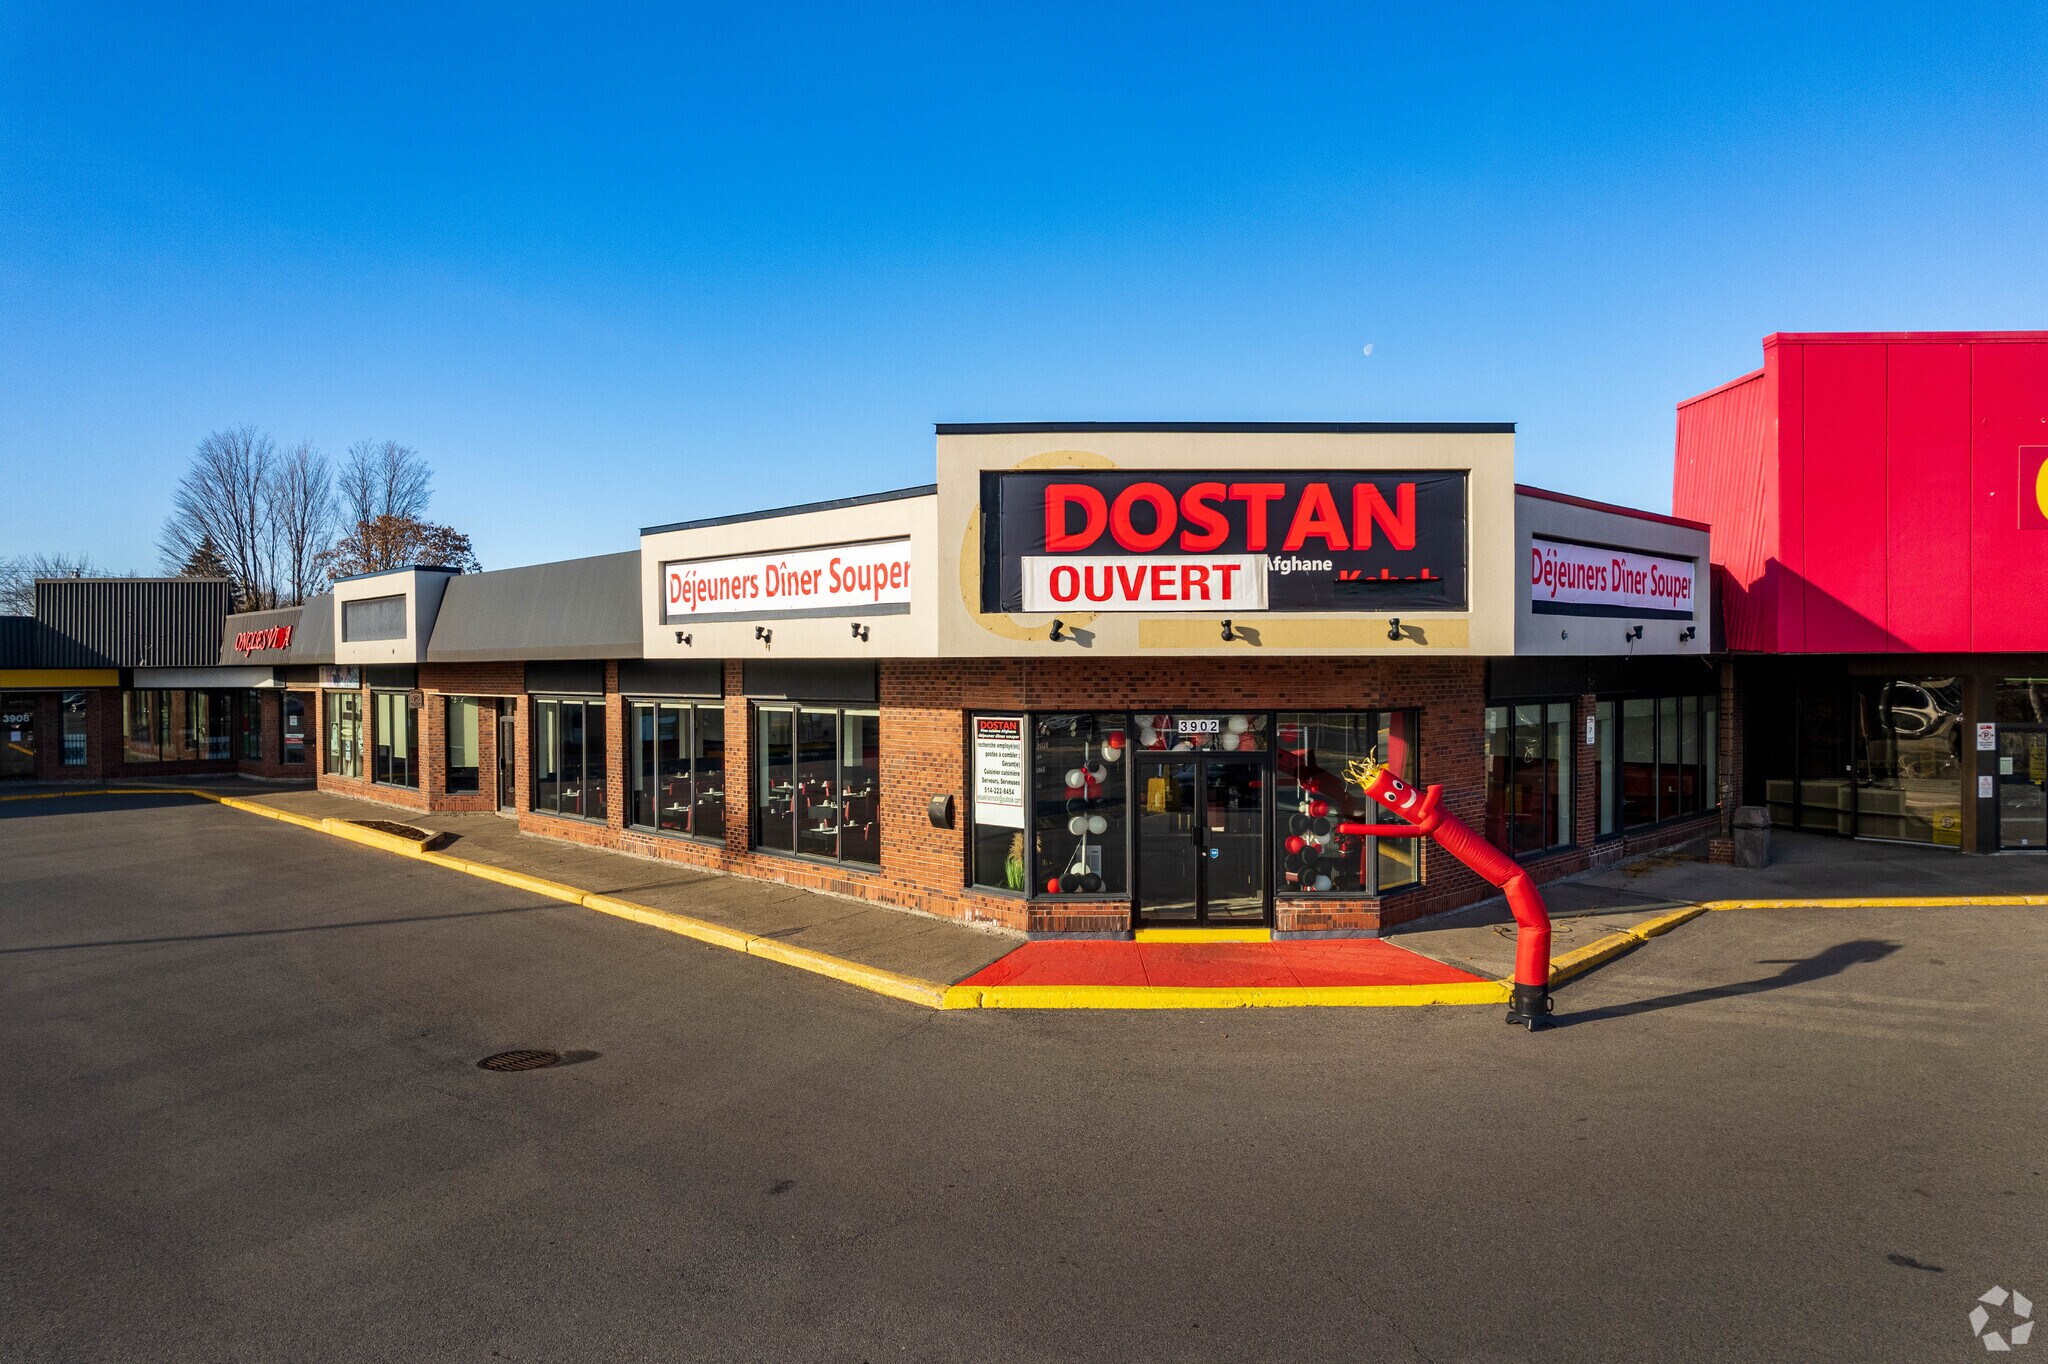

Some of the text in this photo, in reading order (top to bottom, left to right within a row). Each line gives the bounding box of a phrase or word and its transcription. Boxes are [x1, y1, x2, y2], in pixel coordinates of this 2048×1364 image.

[1045, 482, 1416, 553] DOSTAN
[670, 557, 911, 612] Déjeuners Dîner Souper
[1049, 564, 1242, 602] OUVERT
[1532, 547, 1691, 607] Déjeuners Dîner Souper
[3, 714, 30, 723] 3908
[980, 721, 1017, 730] DOSTAN
[1180, 721, 1218, 732] 3902
